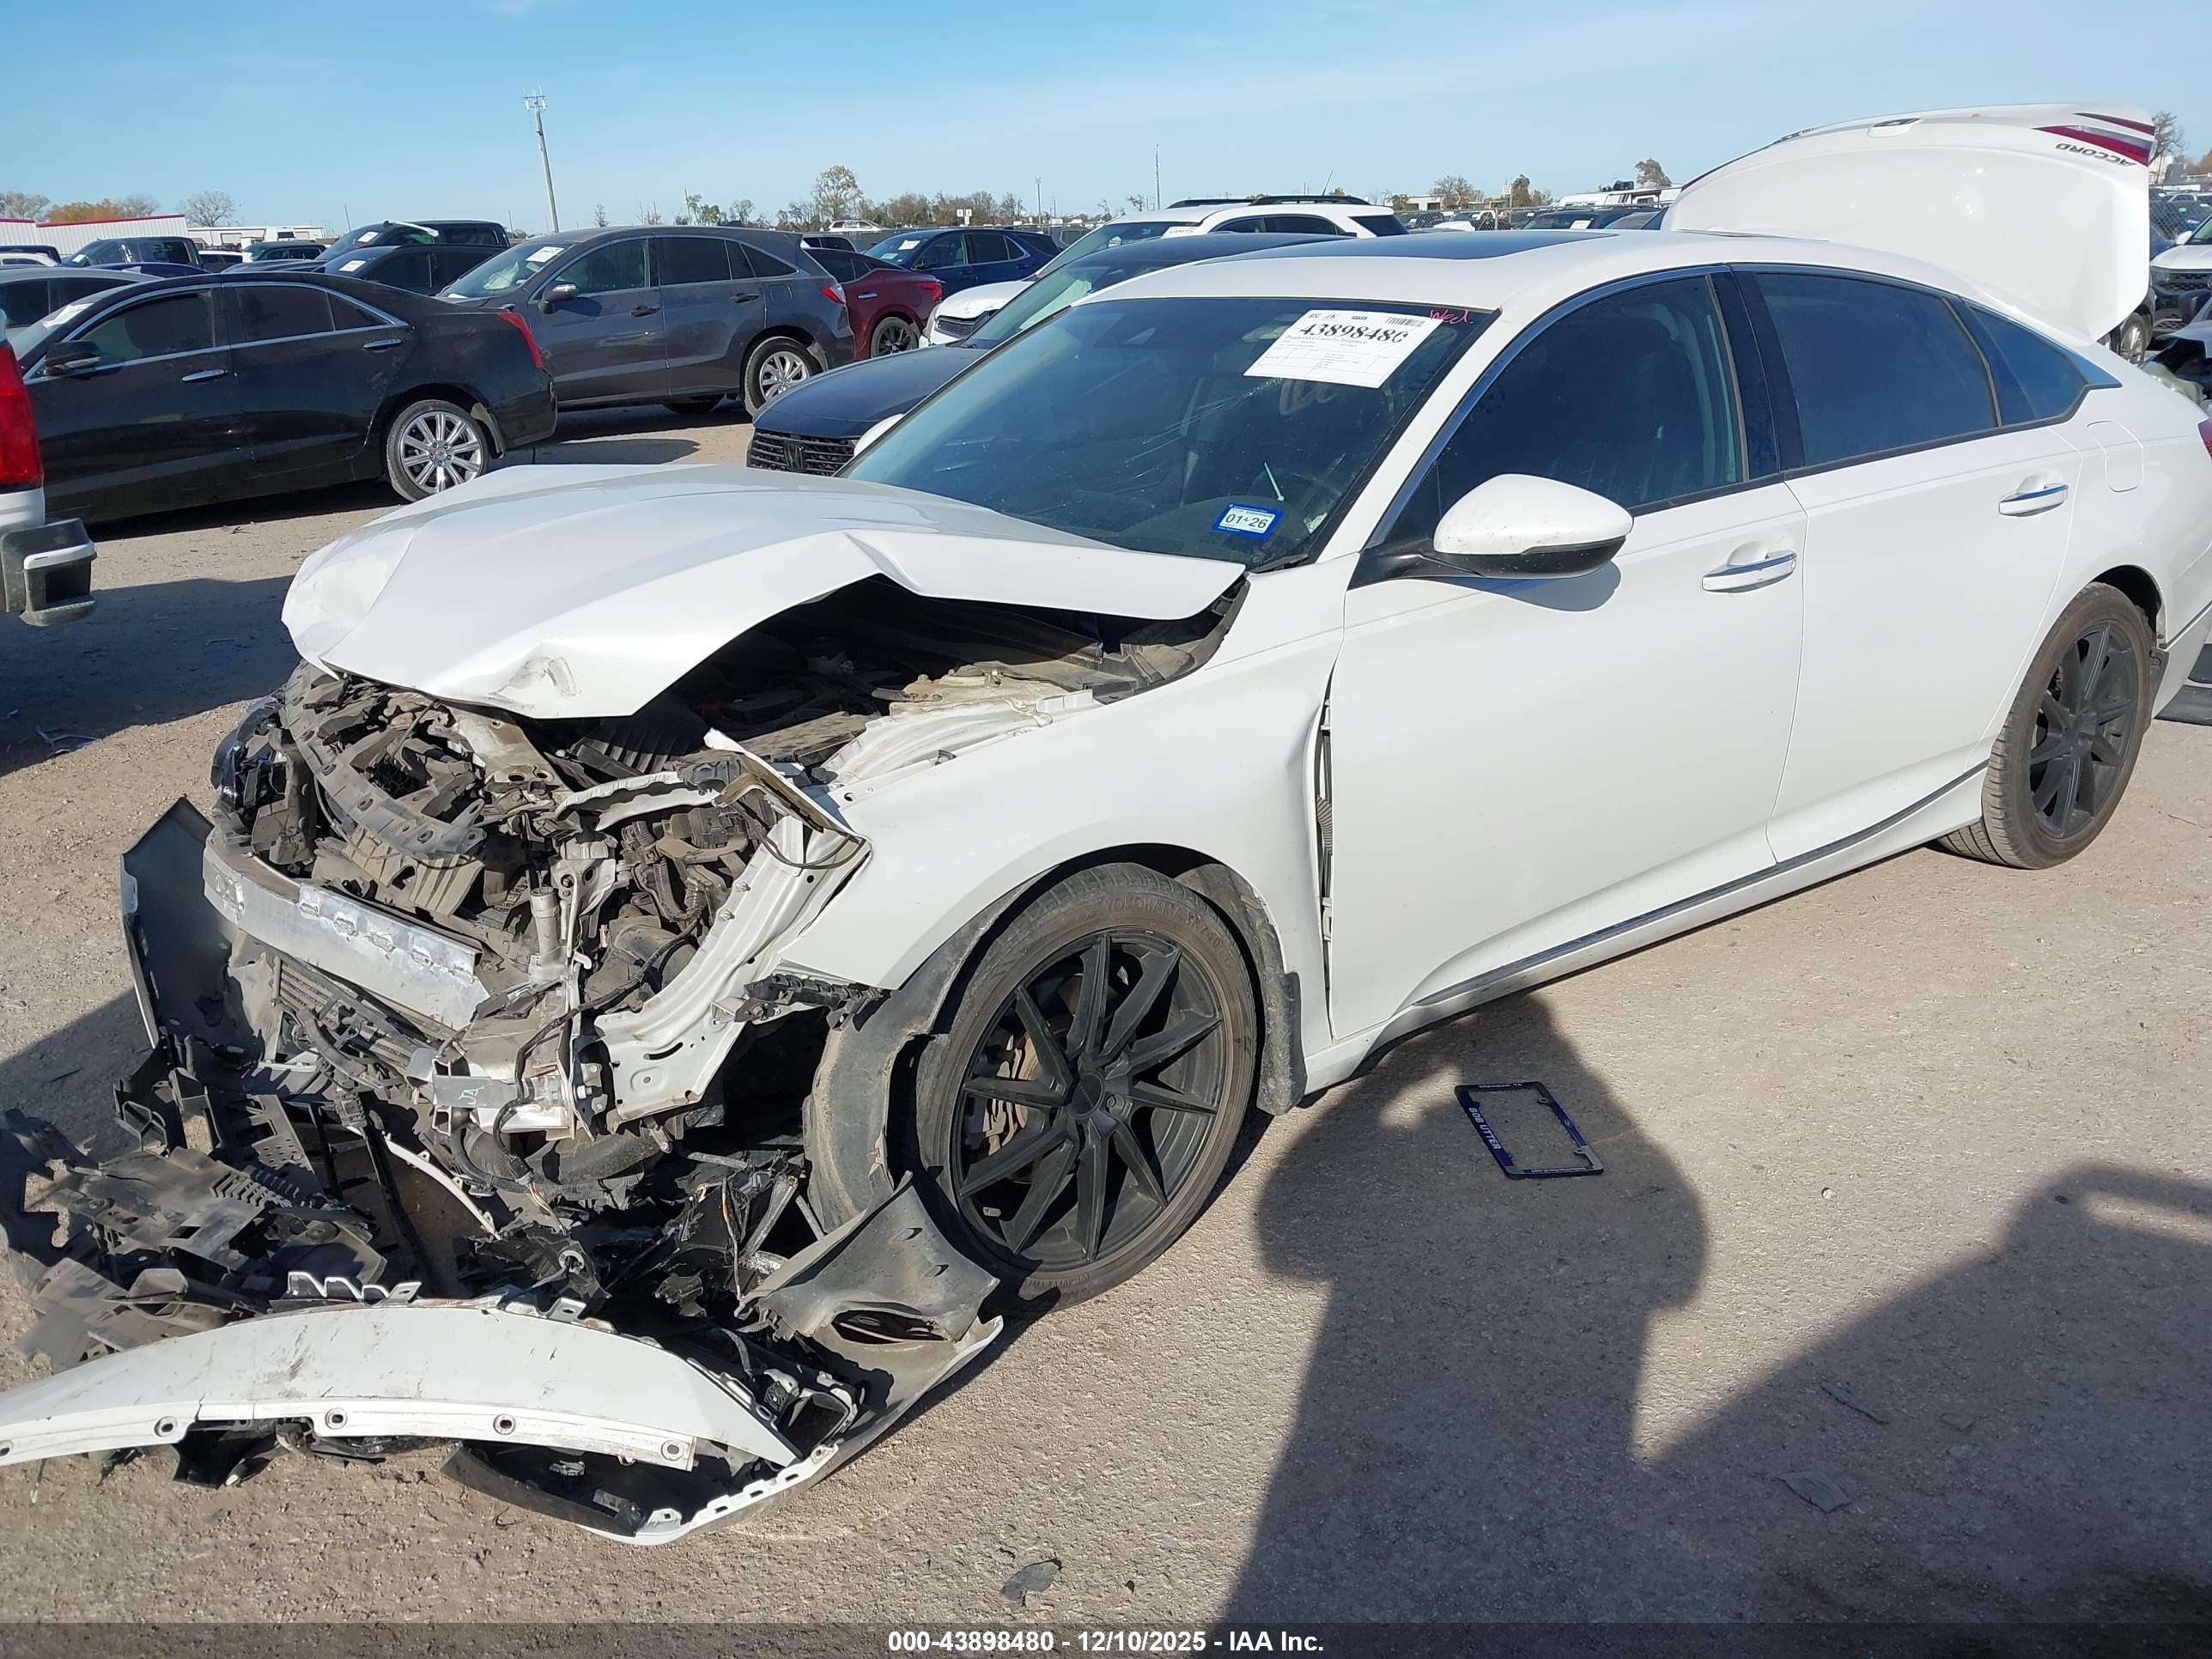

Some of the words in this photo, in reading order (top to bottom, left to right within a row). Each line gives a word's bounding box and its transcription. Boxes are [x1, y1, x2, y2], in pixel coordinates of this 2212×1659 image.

[2055, 143, 2138, 167] ACCORD
[1225, 514, 1243, 525] 01
[1249, 517, 1268, 529] 26
[1468, 1107, 1485, 1123] BOB
[1480, 1124, 1502, 1150] UTTER
